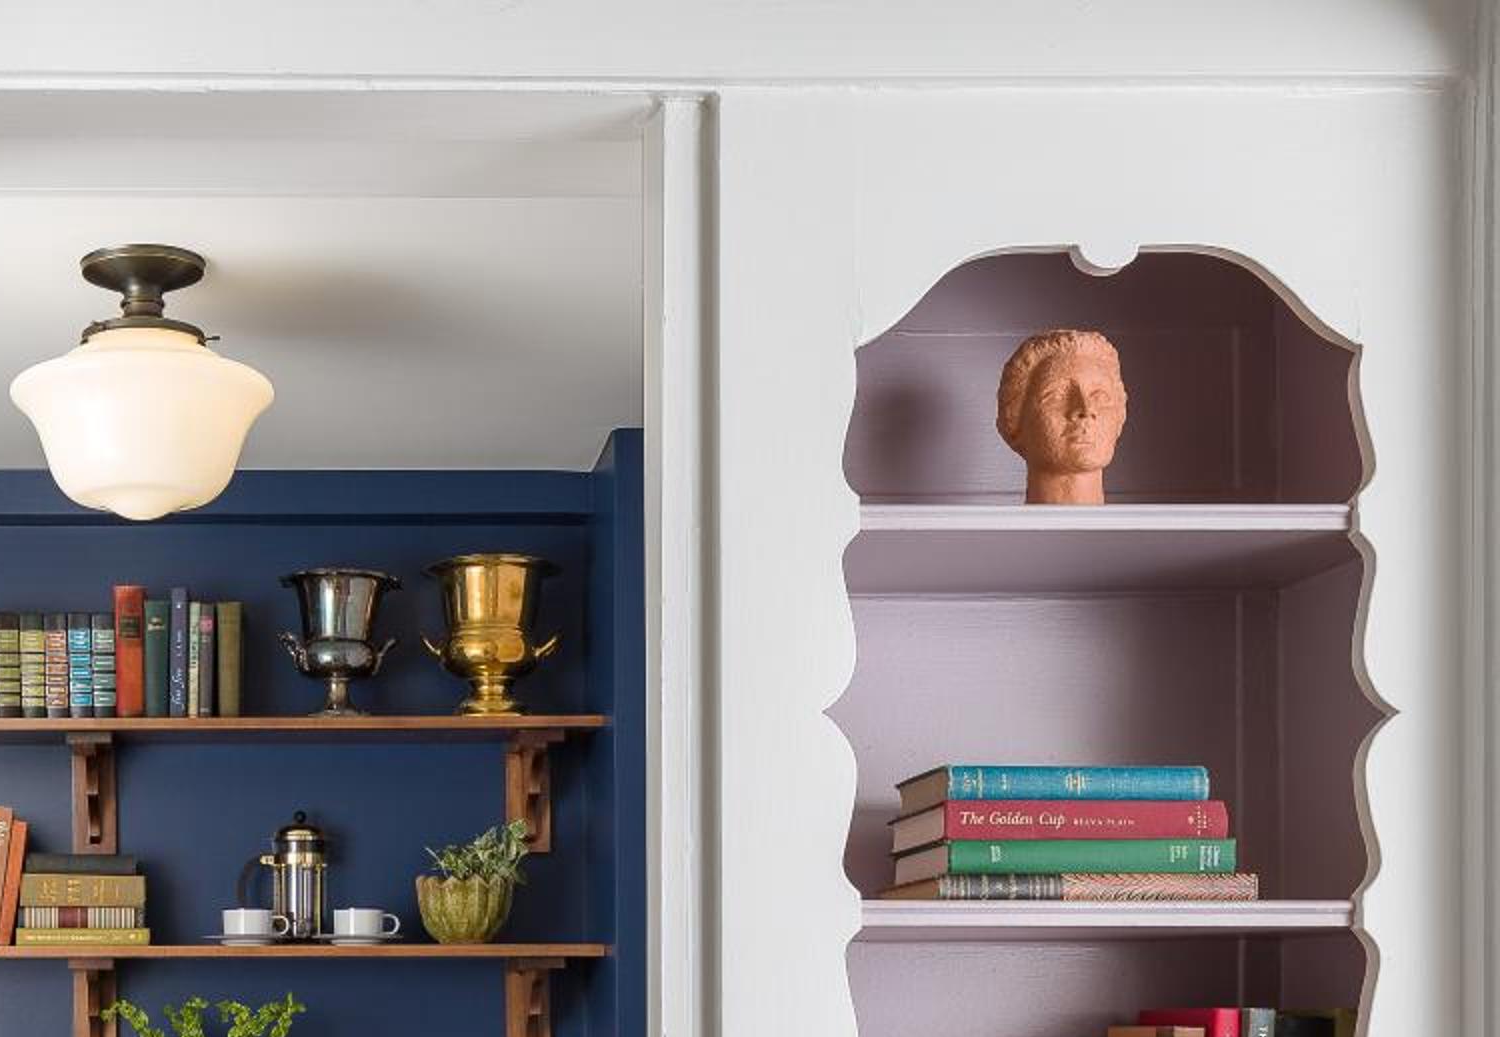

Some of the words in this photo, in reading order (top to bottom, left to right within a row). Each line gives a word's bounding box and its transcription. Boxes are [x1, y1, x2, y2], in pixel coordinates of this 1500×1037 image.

[959, 810, 985, 826] The
[988, 810, 1034, 827] Golden
[1038, 811, 1067, 830] Cup
